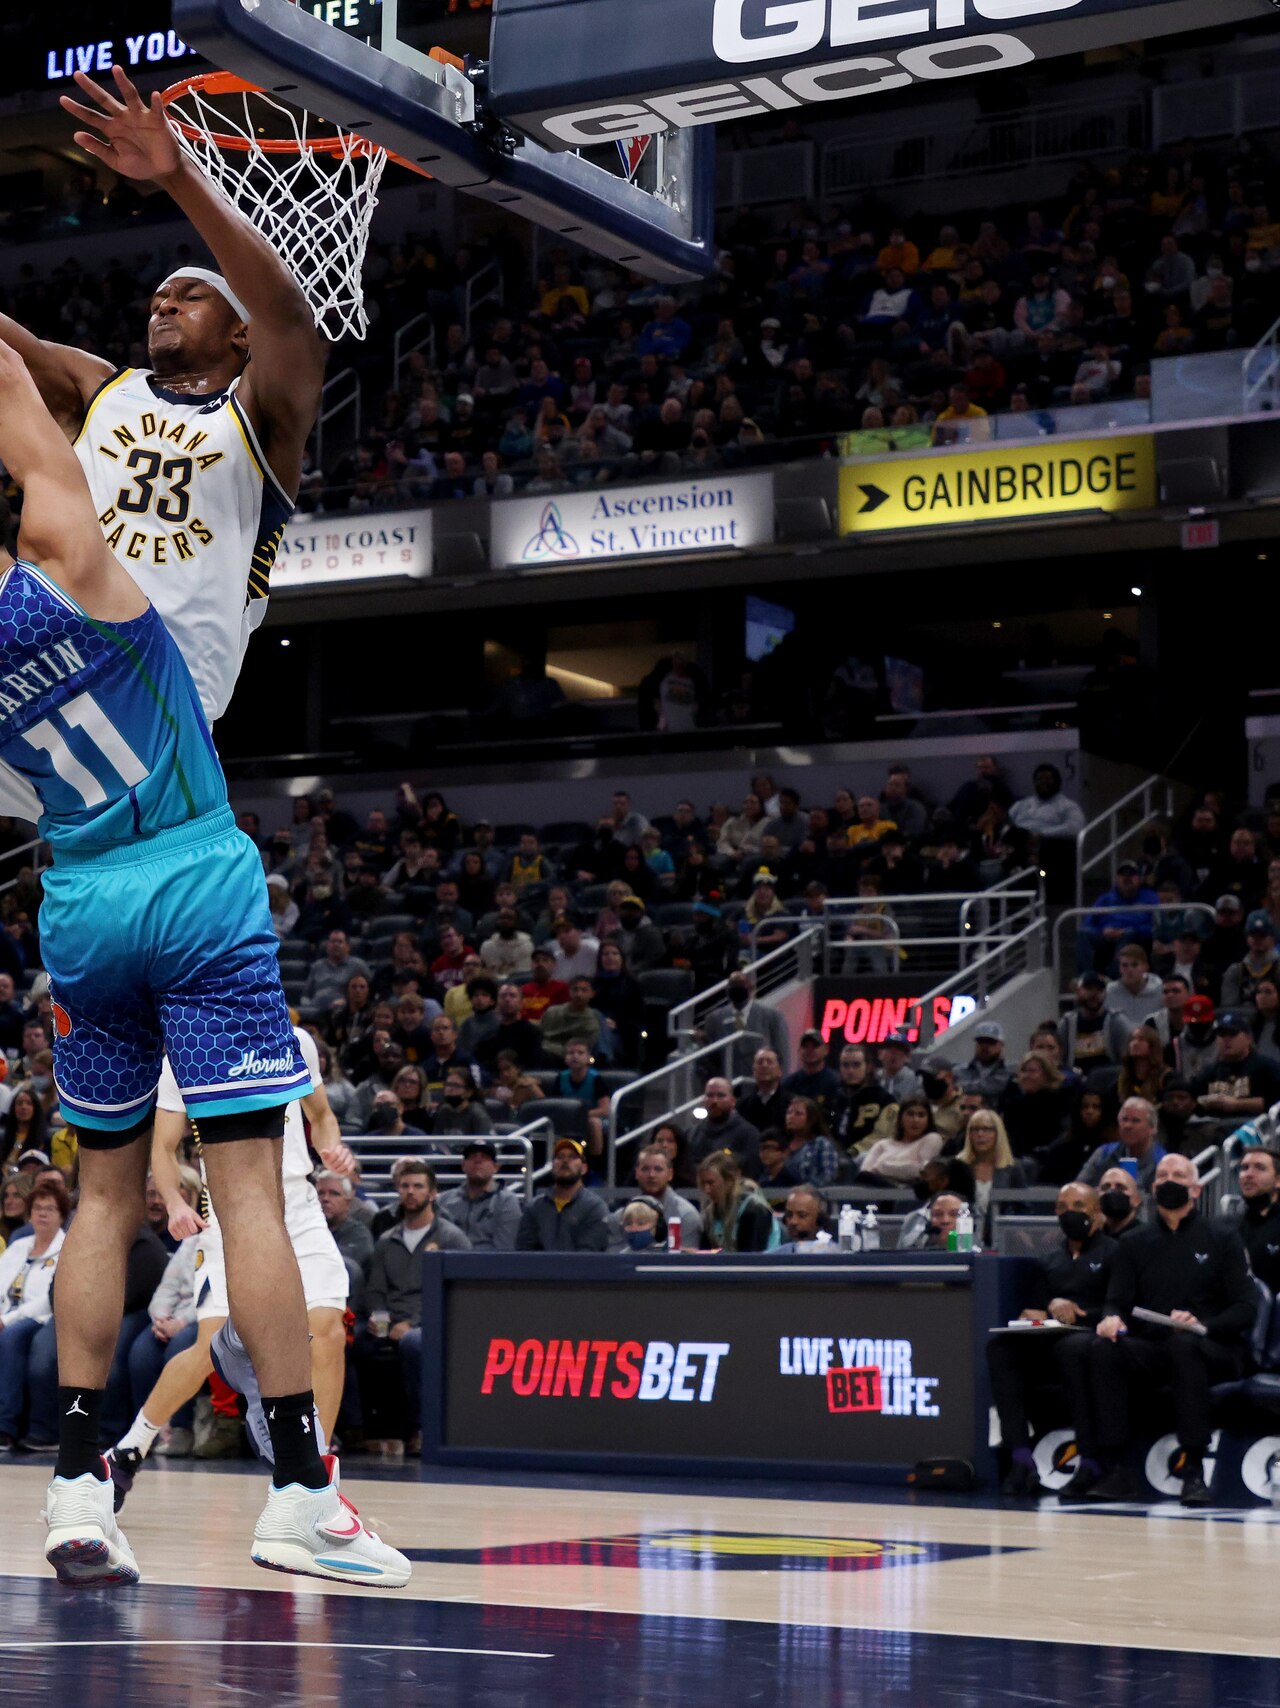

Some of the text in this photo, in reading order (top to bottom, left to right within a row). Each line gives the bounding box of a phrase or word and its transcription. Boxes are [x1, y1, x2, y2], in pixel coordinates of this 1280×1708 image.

[46, 29, 197, 80] LIVE YOU
[542, 33, 1036, 145] GEICO
[97, 411, 225, 473] INDIANA
[116, 447, 193, 524] 33
[592, 485, 735, 521] Ascension
[902, 452, 1137, 513] GAINBRIDGE
[98, 504, 215, 566] PACERS
[274, 548, 412, 572] MPORTS
[278, 535, 319, 556] AST
[345, 525, 418, 549] COAST
[590, 517, 738, 556] St. Vincent
[21, 691, 150, 808] 11
[227, 1047, 294, 1077] Hornets
[481, 1338, 730, 1402] POINTSBET
[780, 1336, 912, 1377] LIVE YOUR
[831, 1371, 876, 1408] BET
